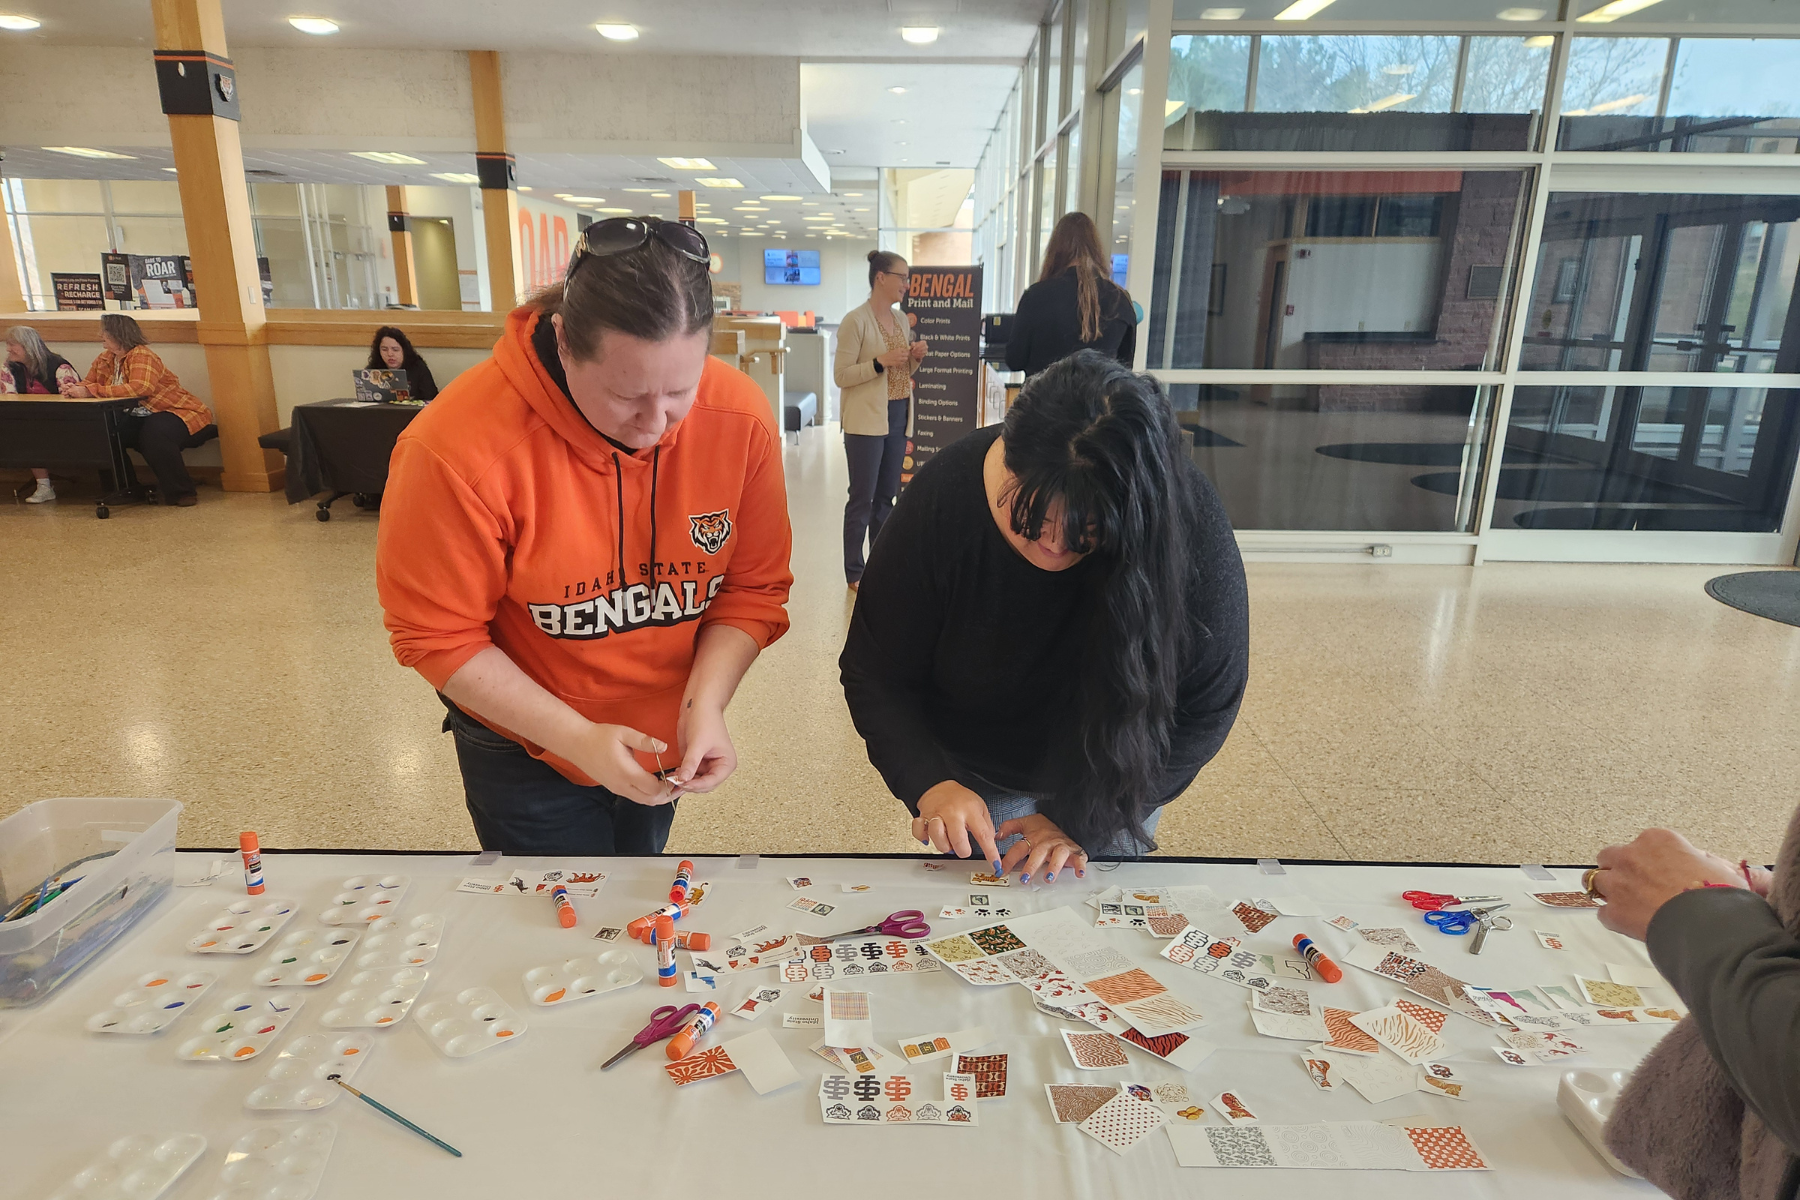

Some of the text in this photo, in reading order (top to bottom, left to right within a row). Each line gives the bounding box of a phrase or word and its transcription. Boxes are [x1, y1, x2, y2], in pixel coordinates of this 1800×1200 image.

[146, 261, 176, 276] ROAR
[909, 273, 974, 297] BENGAL
[908, 298, 973, 308] Print and Mail
[920, 333, 934, 341] Black
[952, 368, 973, 376] Printing
[918, 382, 946, 391] Laminating
[916, 446, 934, 454] Mailing
[564, 562, 706, 598] IDAH STATE
